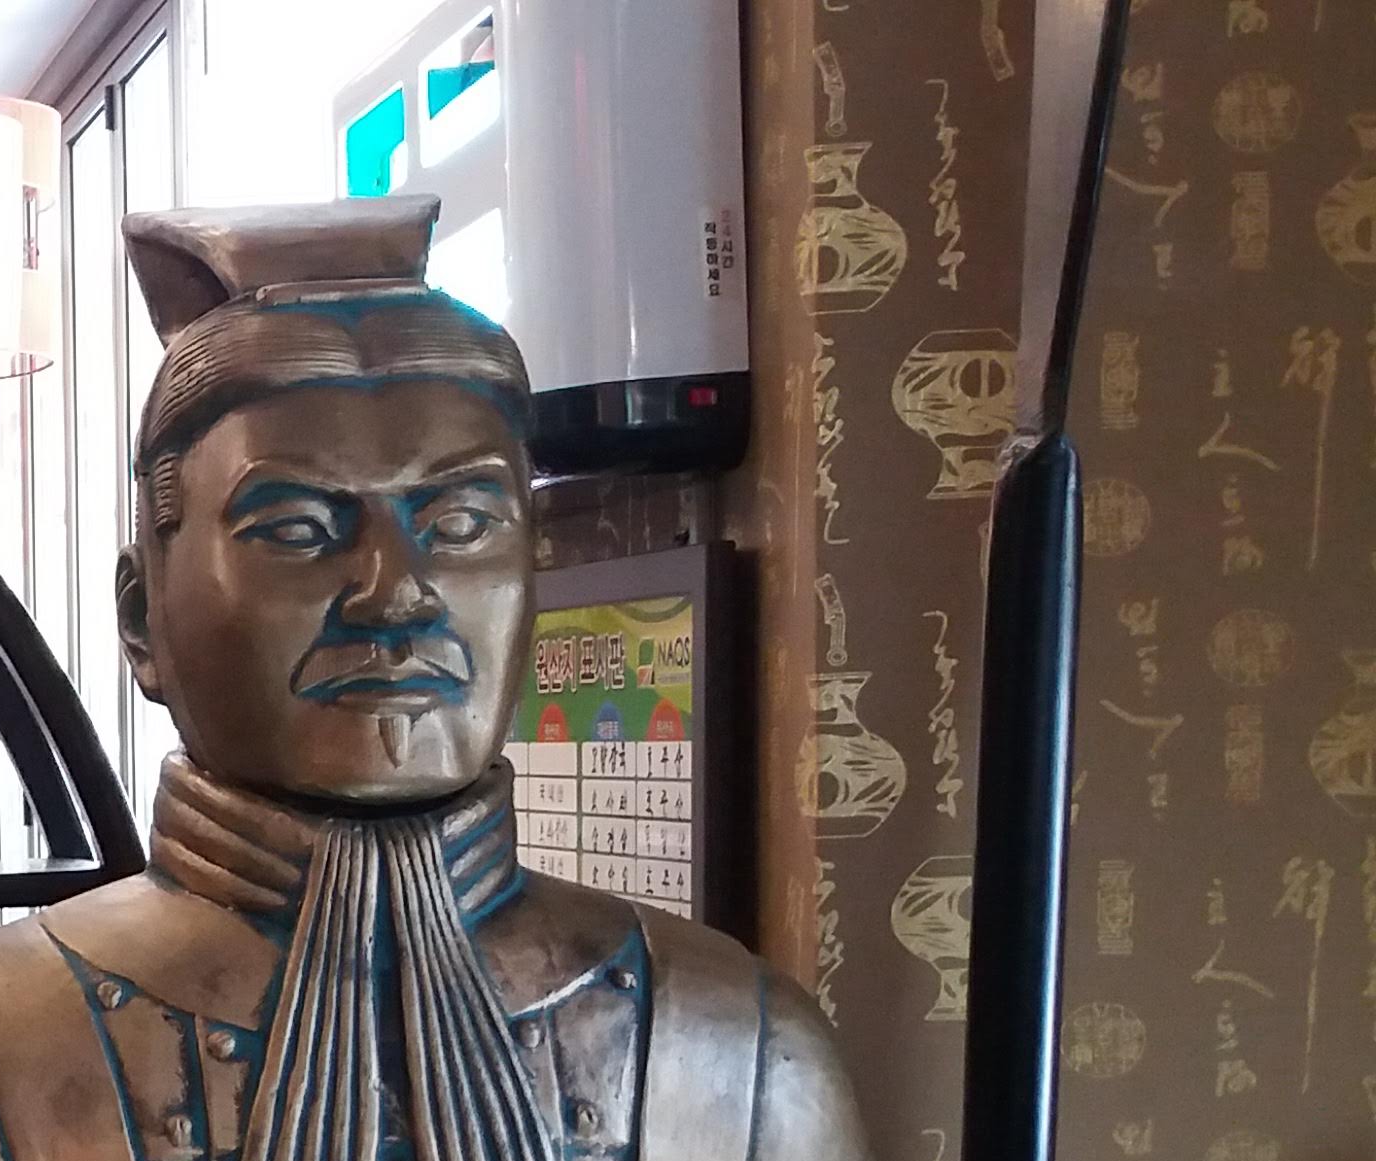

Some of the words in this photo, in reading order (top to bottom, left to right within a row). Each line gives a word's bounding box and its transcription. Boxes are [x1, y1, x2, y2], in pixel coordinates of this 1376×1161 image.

[536, 635, 576, 693] 원산지
[579, 632, 625, 691] 표시판
[657, 635, 690, 668] NAQS
